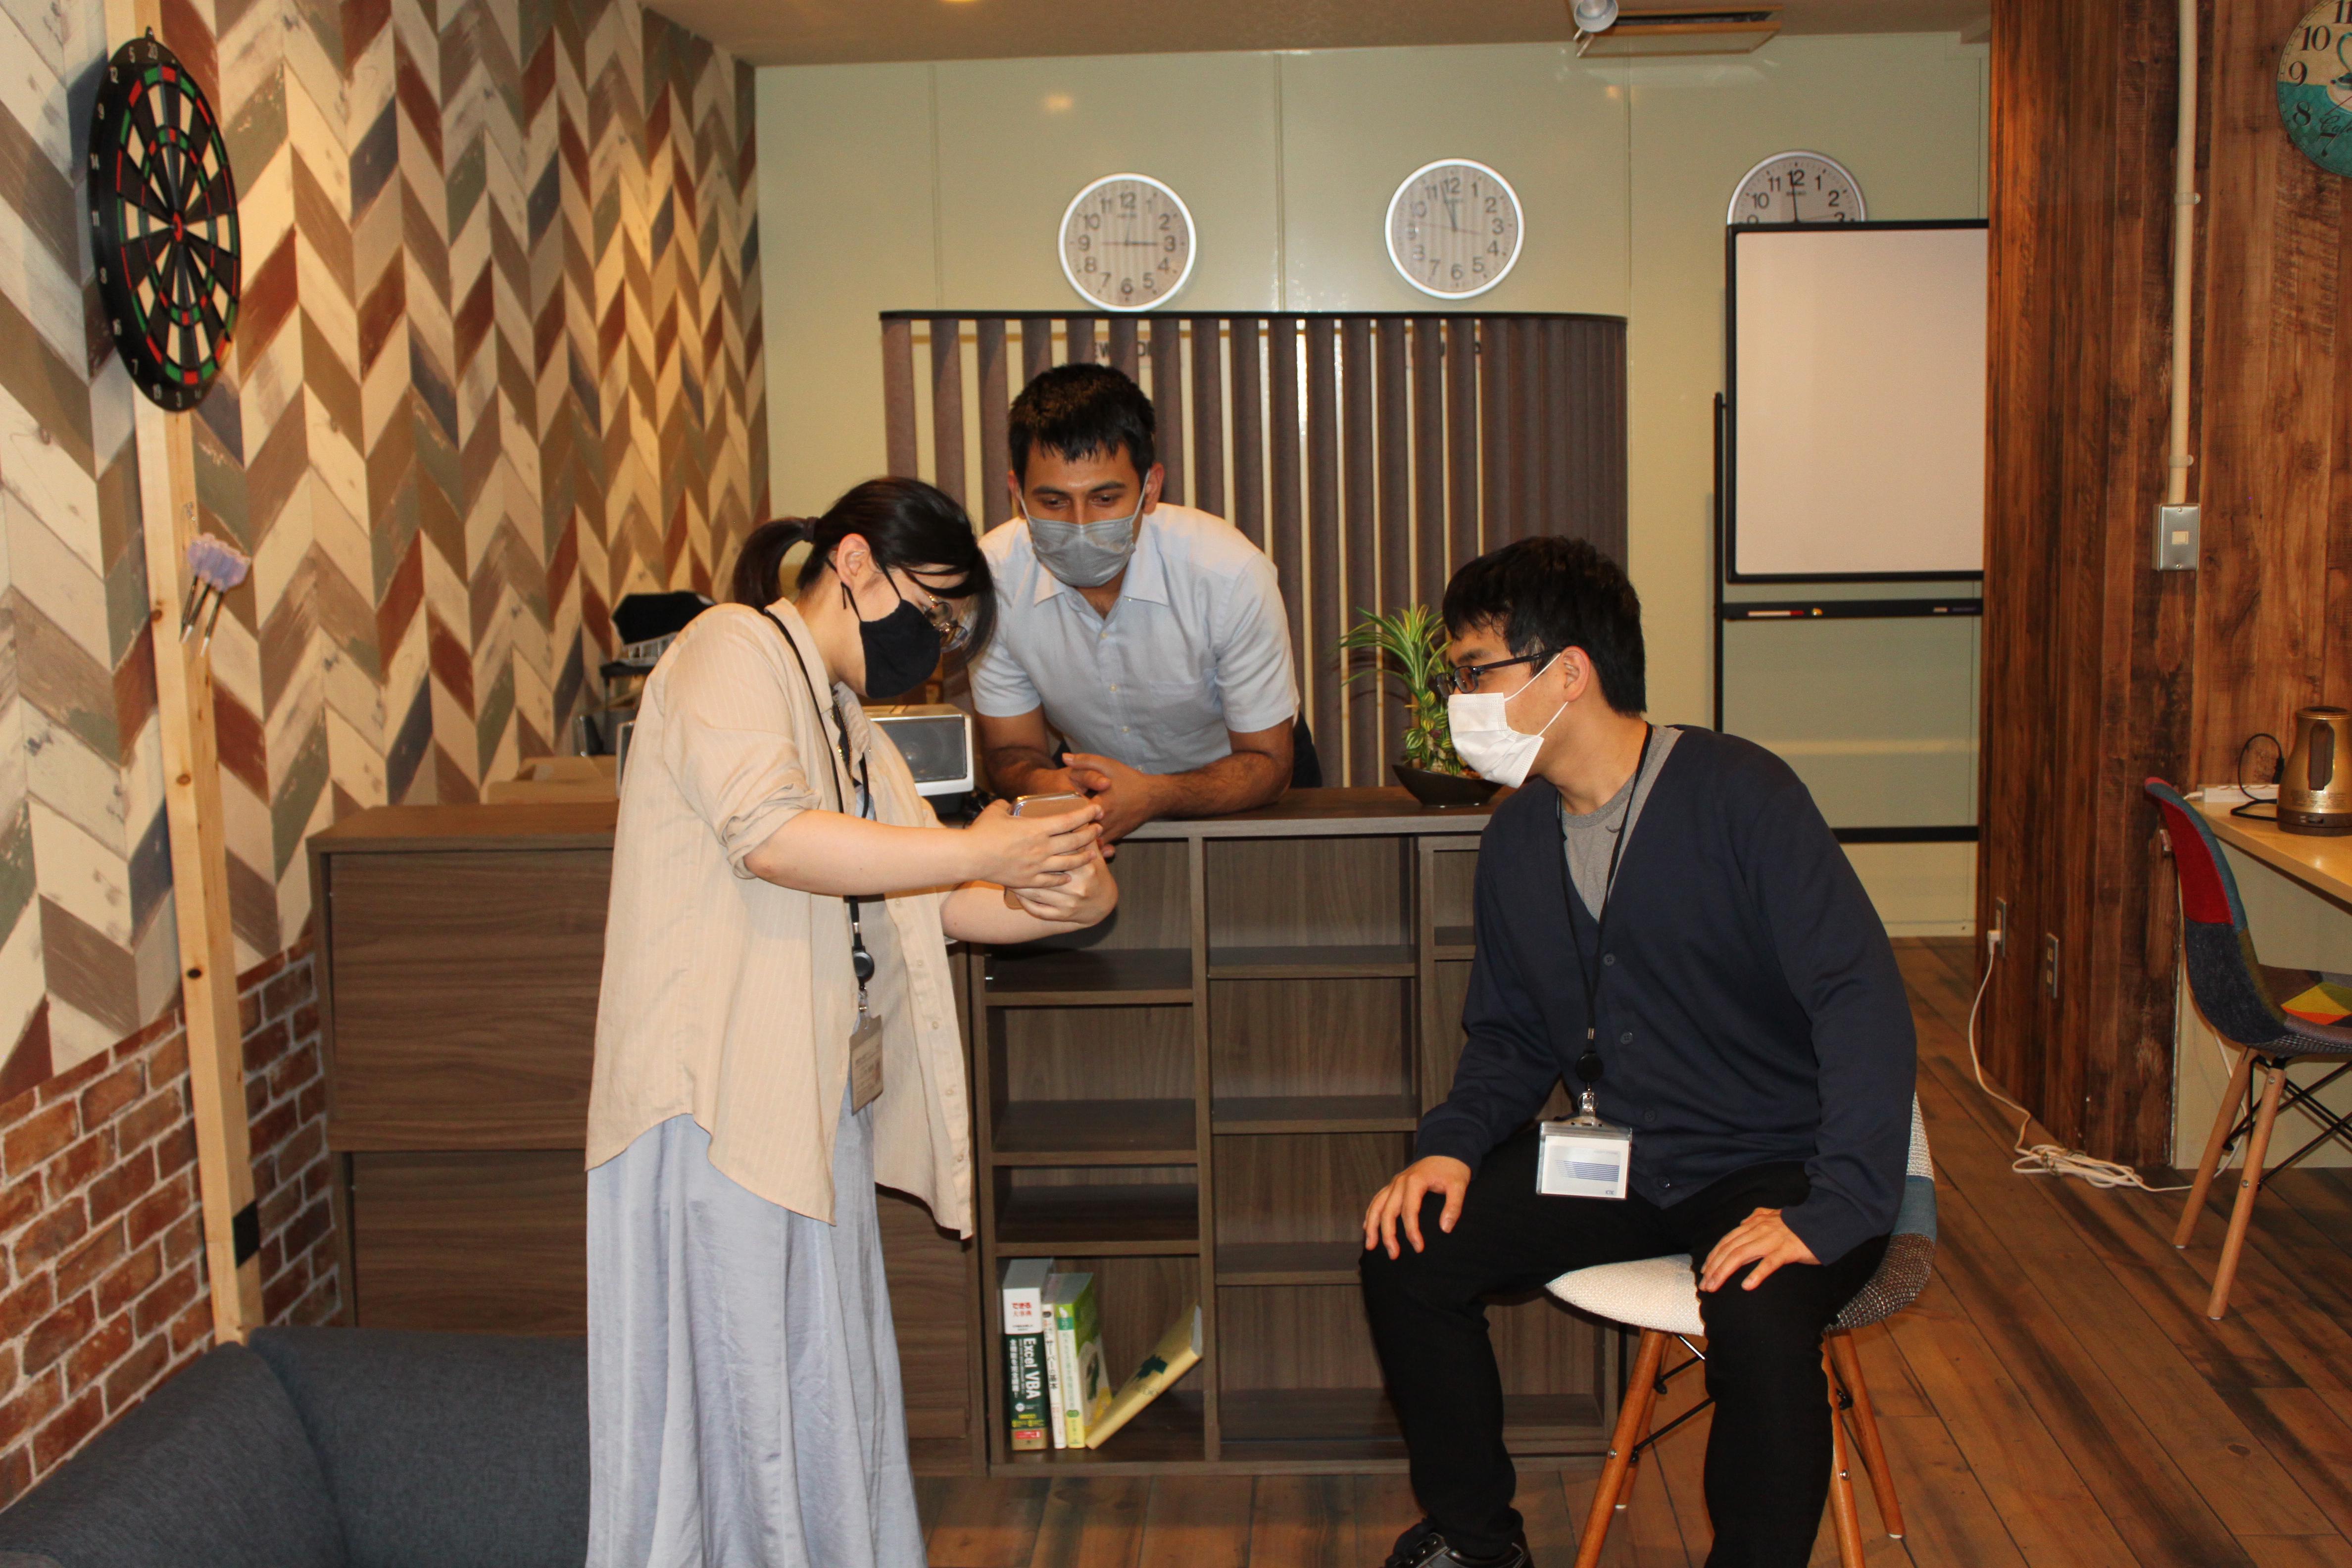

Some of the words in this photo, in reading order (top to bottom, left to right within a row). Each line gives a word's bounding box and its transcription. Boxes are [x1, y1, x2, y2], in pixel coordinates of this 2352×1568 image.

[2300, 25, 2330, 51] 10
[2288, 60, 2307, 88] 9
[2293, 101, 2311, 127] 8
[1444, 177, 1461, 194] 12
[1768, 176, 1781, 192] 11
[1787, 169, 1805, 187] 12
[1815, 175, 1822, 191] 1
[1425, 185, 1438, 200] 11
[1471, 181, 1478, 196] 1
[1100, 197, 1112, 213] 11
[1120, 191, 1135, 209] 12
[1146, 199, 1153, 211] 1
[1485, 196, 1497, 213] 2
[1752, 192, 1769, 209] 10
[1828, 190, 1839, 207] 2
[1411, 201, 1427, 218] 10
[1084, 213, 1100, 230] 10
[1159, 213, 1170, 230] 2
[1492, 218, 1504, 235] 3
[1078, 235, 1090, 251] 9
[1164, 235, 1176, 252] 3
[1487, 239, 1500, 256] 4
[1084, 256, 1097, 273] 8
[1157, 257, 1170, 274] 4
[1429, 258, 1441, 276] 7
[1451, 263, 1464, 280] 6
[1472, 256, 1485, 273] 5
[1100, 271, 1111, 288] 7
[1121, 277, 1133, 294] 6
[1142, 272, 1154, 289] 5
[131, 358, 139, 375] 7
[1023, 1337, 1038, 1369] Excel
[1025, 1371, 1042, 1400] VBA
